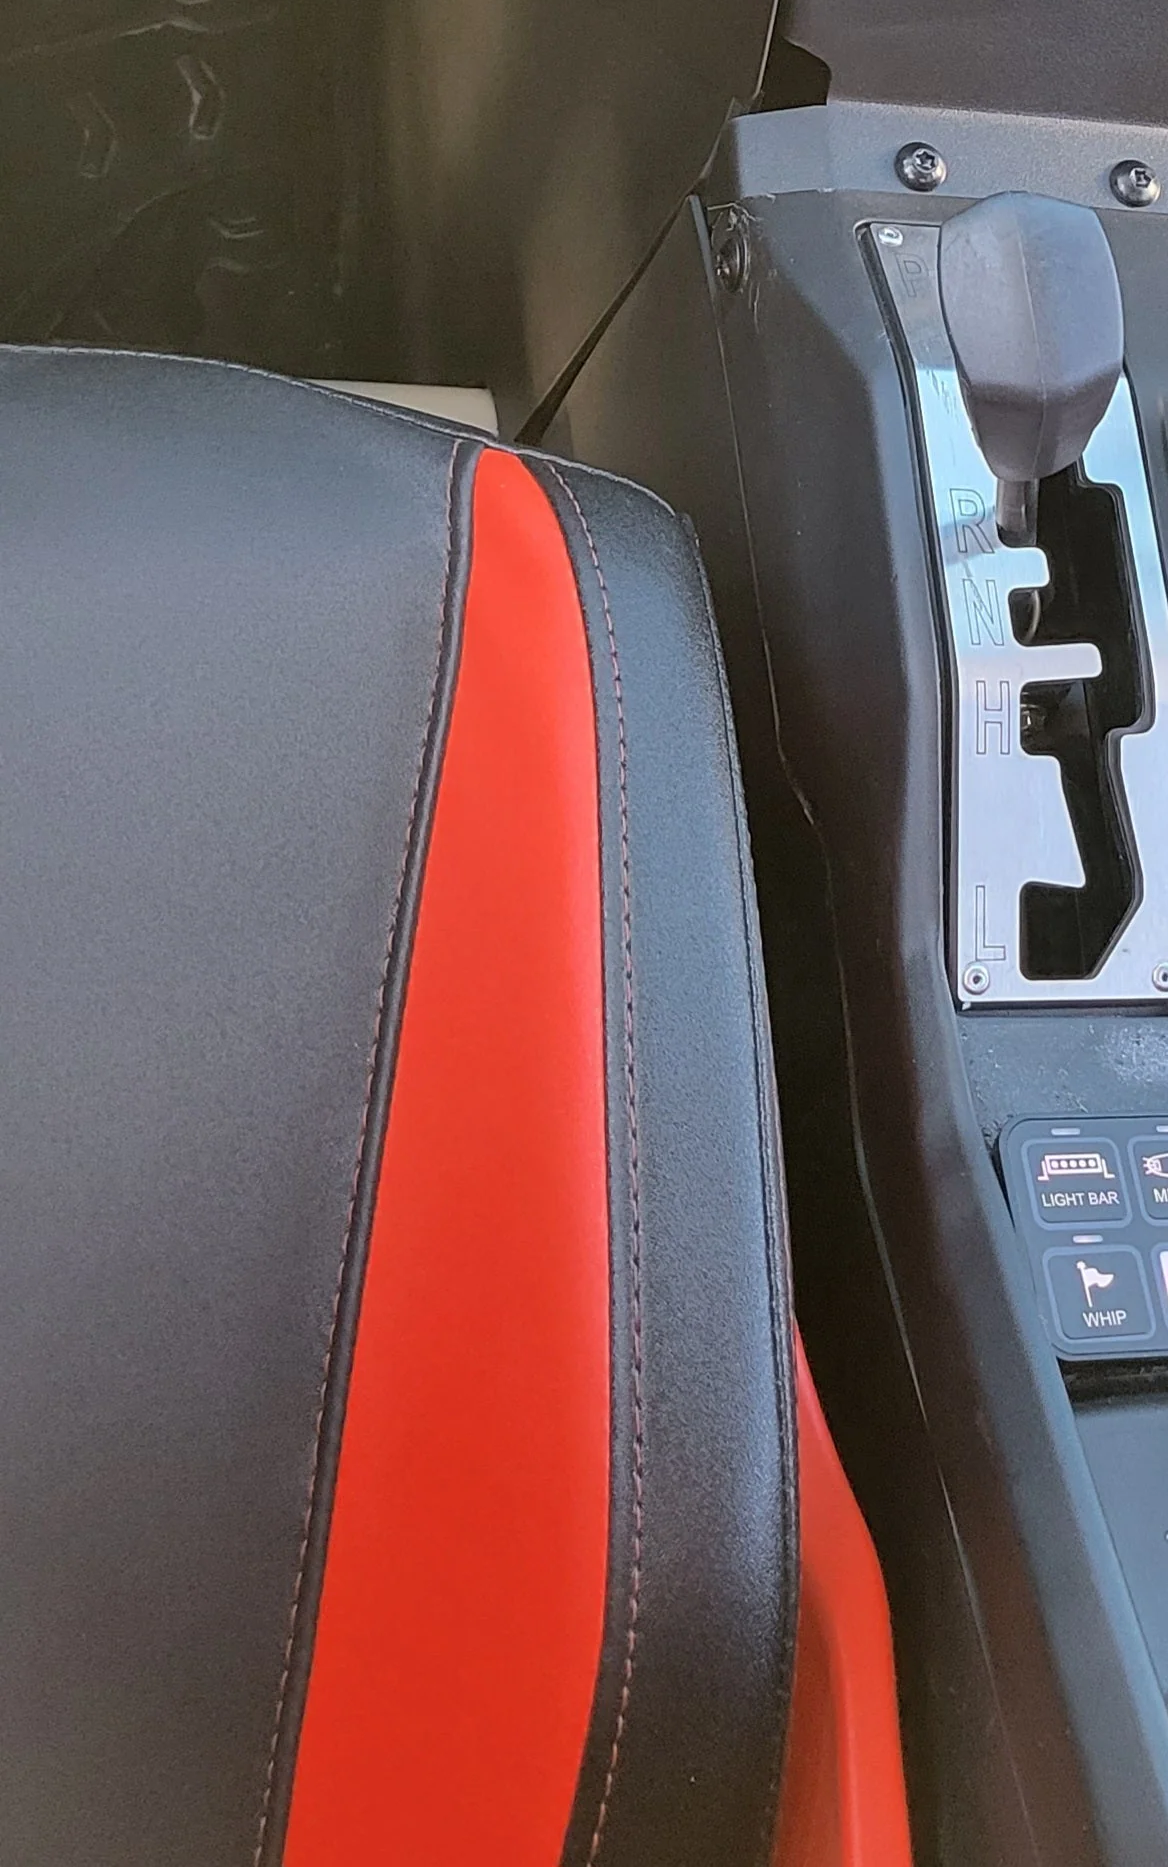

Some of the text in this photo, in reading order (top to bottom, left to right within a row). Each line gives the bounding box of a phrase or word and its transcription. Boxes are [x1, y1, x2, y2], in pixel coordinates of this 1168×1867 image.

[895, 252, 930, 298] P
[949, 487, 995, 554] R
[962, 578, 1005, 646] N
[975, 680, 1011, 755] H
[975, 884, 1006, 961] L
[1041, 1190, 1120, 1208] LIGHT BAR
[1082, 1309, 1127, 1329] WHIP
